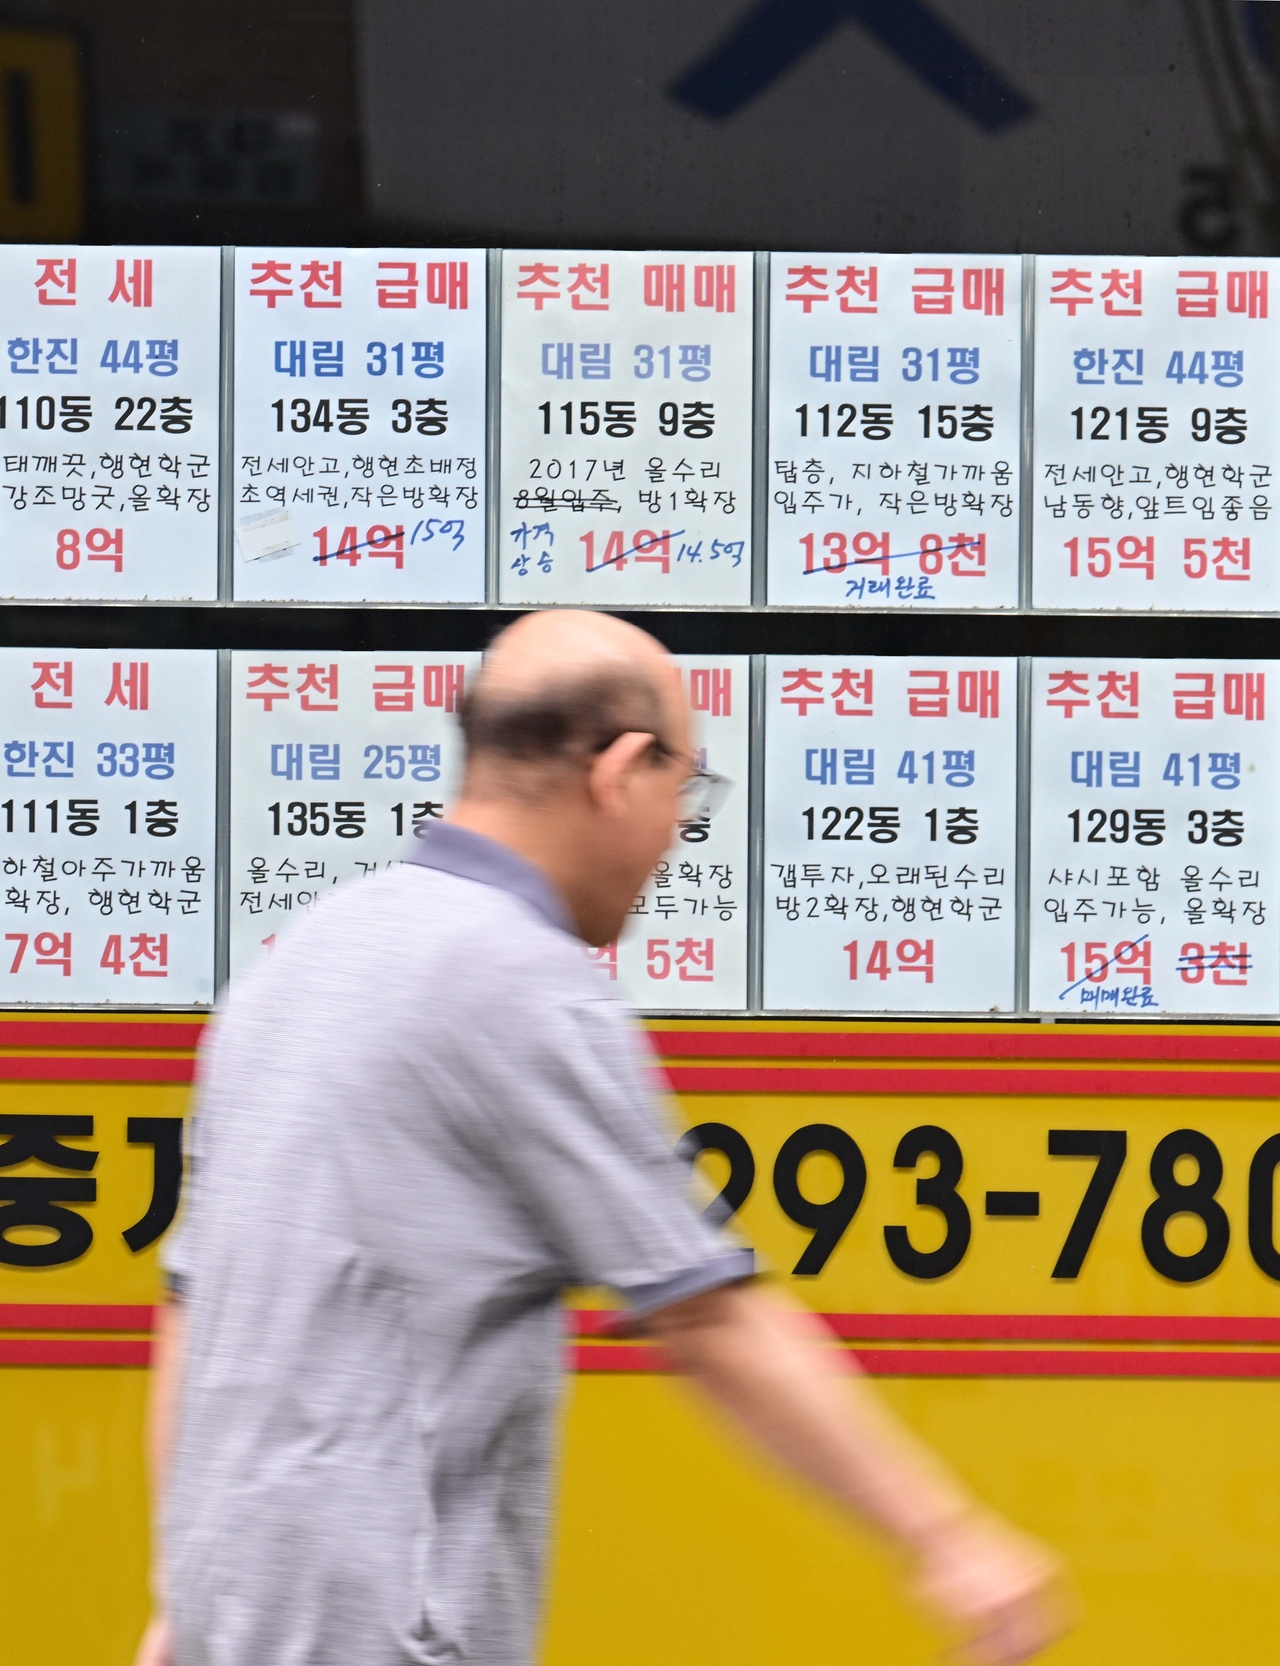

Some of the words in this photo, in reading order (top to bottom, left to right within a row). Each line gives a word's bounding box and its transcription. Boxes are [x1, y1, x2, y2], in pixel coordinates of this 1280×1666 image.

[36, 259, 76, 305] 전
[109, 260, 152, 307] 세
[250, 260, 342, 308] 추천
[377, 262, 468, 309] 급매
[518, 263, 608, 310] 추천
[644, 265, 735, 312] 매매
[786, 266, 877, 313] 추천
[912, 268, 1004, 315] 급매
[1050, 269, 1142, 316] 추천
[1177, 271, 1268, 318] 급매
[7, 337, 78, 375] 한진
[100, 339, 179, 378] 44평
[273, 340, 344, 379] 대림
[365, 341, 445, 380] 31평
[541, 343, 611, 380] 대림
[634, 344, 712, 381] 31평
[809, 346, 879, 383] 대림
[901, 347, 980, 385] 31평
[1073, 348, 1143, 386] 한진
[1165, 350, 1243, 388] 44평
[0, 396, 92, 432] 110동
[115, 397, 192, 433] 22층
[272, 399, 369, 435] 134동
[392, 399, 448, 435] 3층
[539, 401, 636, 437] 115동
[659, 402, 714, 438] 9층
[796, 404, 893, 440] 112동
[919, 405, 993, 441] 15층
[1072, 407, 1168, 443] 121동
[1192, 408, 1247, 444] 9층
[530, 459, 625, 481] 2017년
[645, 457, 719, 482] 올수리
[775, 459, 833, 484] 탑층,
[853, 461, 1012, 485] 지하철가까움
[639, 488, 735, 514] 방1확장
[775, 492, 861, 515] 입주가,
[880, 491, 1013, 517] 작은방확장
[57, 528, 123, 572] 8억
[313, 525, 404, 569] 14억
[579, 530, 671, 573] 14억
[799, 532, 890, 576] 13억
[919, 533, 985, 577] 8천
[1065, 536, 1154, 580] 15억
[1184, 537, 1250, 580] 5천
[32, 662, 72, 708] 전
[106, 662, 148, 710] 세
[247, 664, 338, 711] 추천
[373, 664, 465, 713] 급매
[672, 668, 732, 717] 매
[782, 668, 872, 716] 추천
[908, 671, 999, 718] 급매
[1047, 671, 1138, 718] 추천
[1174, 673, 1264, 720] 급매
[4, 740, 74, 778] 한진
[96, 742, 175, 781] 33평
[271, 744, 340, 780] 대림
[364, 745, 440, 782] 25평
[805, 748, 874, 786] 대림
[896, 750, 975, 788] 41평
[1070, 751, 1140, 788] 대림
[1162, 753, 1240, 790] 41평
[2, 800, 99, 836] 111동
[125, 800, 178, 837] 1층
[269, 802, 366, 838] 135동
[803, 807, 900, 843] 122동
[926, 807, 978, 844] 1층
[1069, 809, 1165, 845] 129동
[1189, 810, 1244, 846] 3층
[248, 857, 337, 884] 올수리,
[1049, 866, 1160, 891] 샤시포함
[1181, 866, 1258, 892] 올수리
[6, 887, 69, 915] 확장,
[89, 889, 200, 915] 행현학군
[1045, 899, 1164, 924] 입주가능,
[1184, 898, 1265, 925] 올확장
[6, 932, 71, 976] 7억
[101, 934, 168, 976] 4천
[647, 937, 714, 982] 5천
[844, 940, 933, 983] 14억
[1061, 940, 1151, 985] 15억
[1180, 942, 1248, 986] 3천
